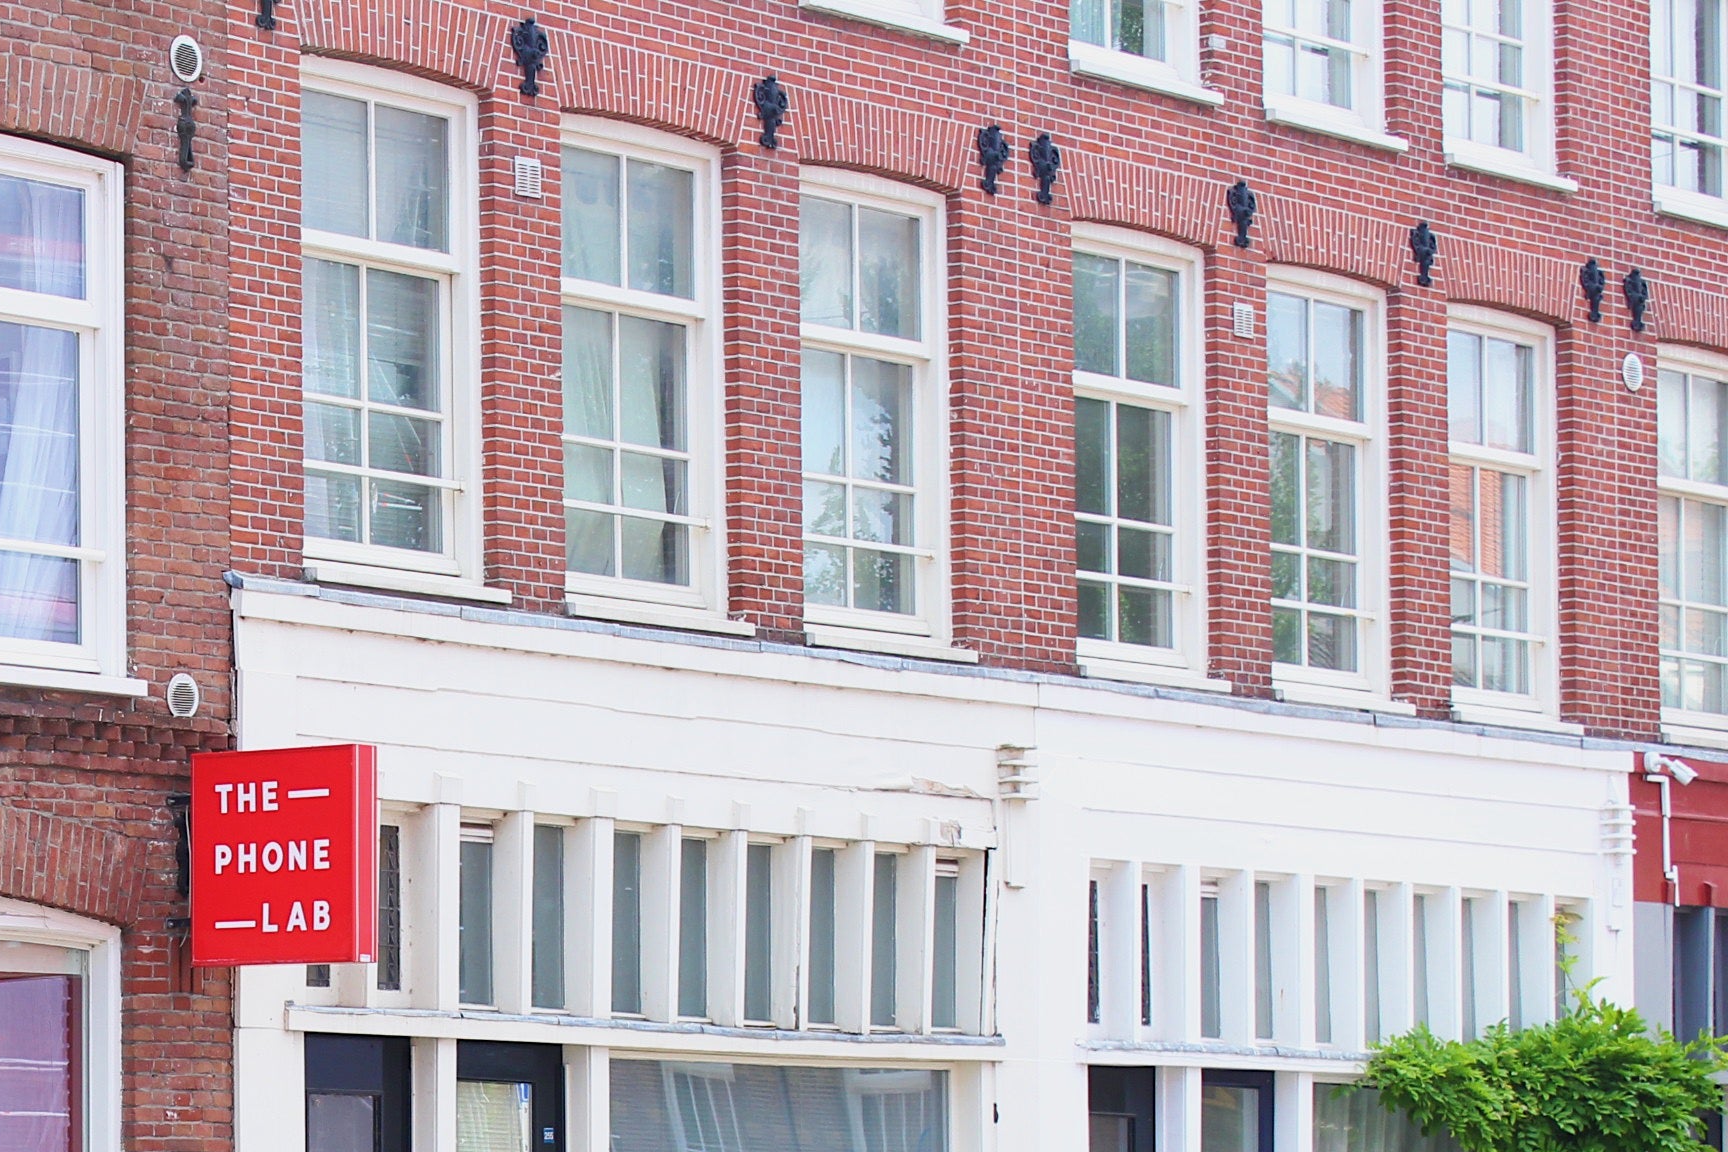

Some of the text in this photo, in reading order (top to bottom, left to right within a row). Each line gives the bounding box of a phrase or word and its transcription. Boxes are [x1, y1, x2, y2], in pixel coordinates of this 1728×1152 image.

[214, 780, 279, 814] THE
[214, 838, 331, 875] PHONE
[261, 899, 331, 933] LAB
